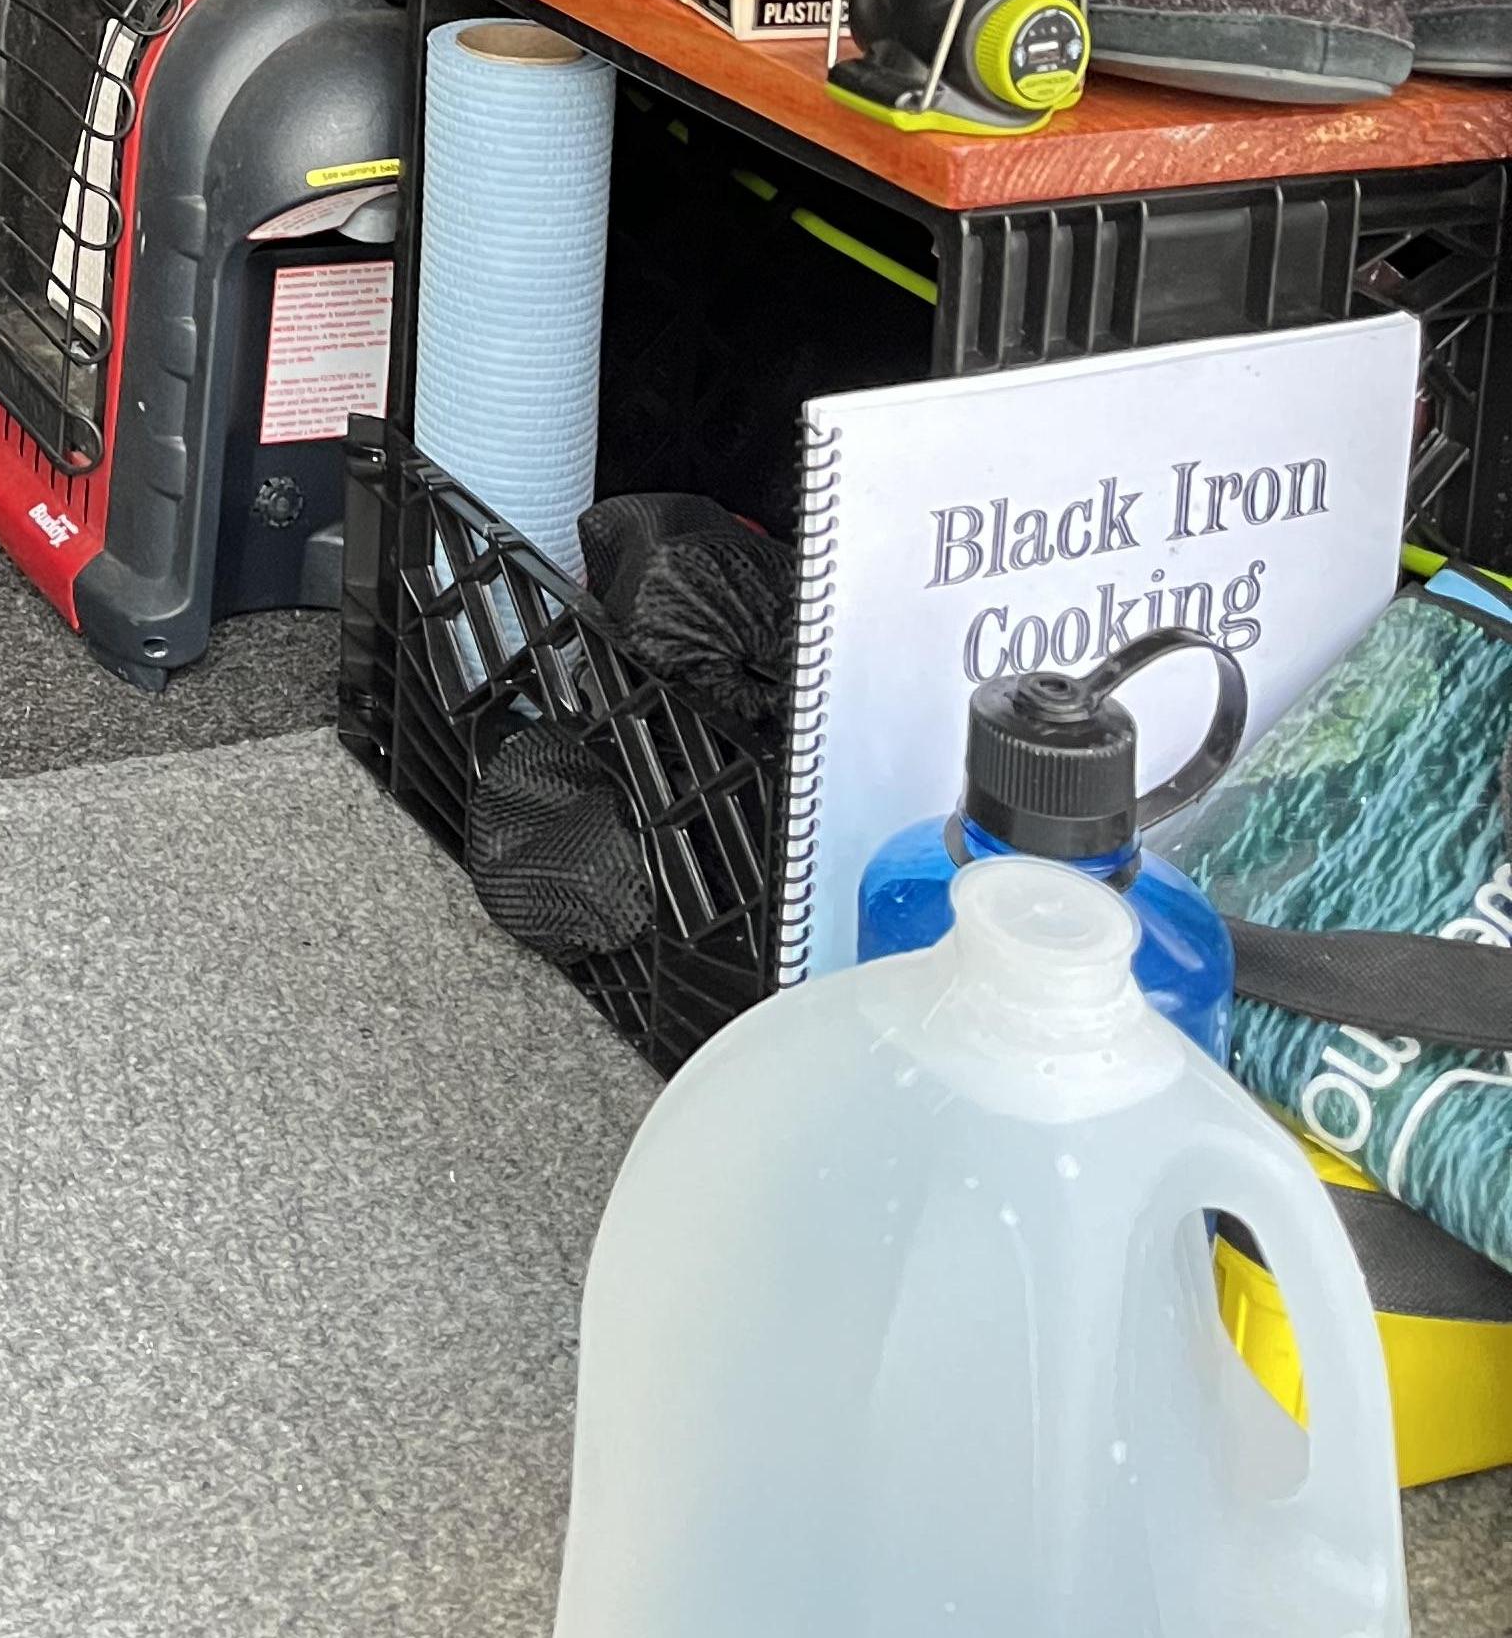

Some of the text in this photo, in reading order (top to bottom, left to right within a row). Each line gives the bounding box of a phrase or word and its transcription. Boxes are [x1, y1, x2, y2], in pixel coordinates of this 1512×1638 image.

[763, 0, 832, 25] PLASTIC
[924, 457, 1329, 589] Black Iron
[962, 559, 1266, 683] Cooking
